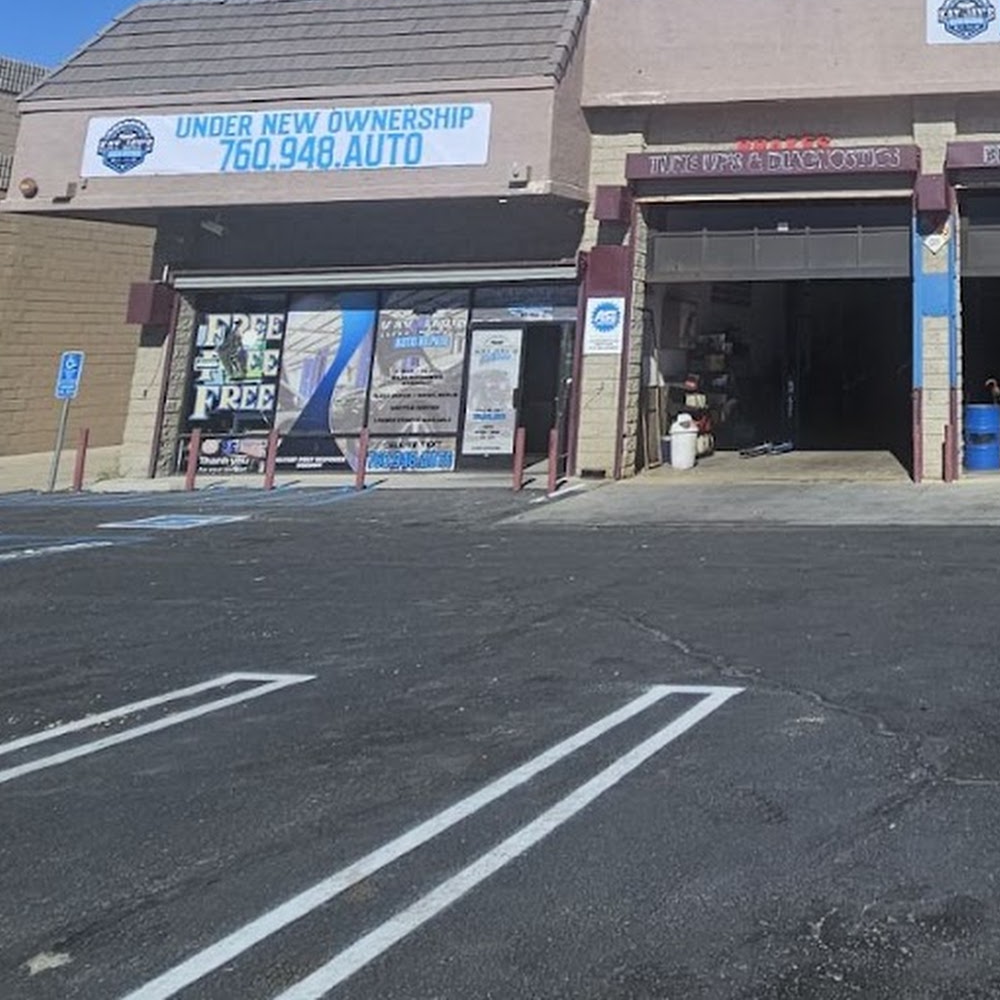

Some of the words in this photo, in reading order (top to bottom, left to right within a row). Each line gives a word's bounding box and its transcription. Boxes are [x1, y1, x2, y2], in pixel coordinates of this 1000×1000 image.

[176, 115, 252, 138] UNDER
[261, 110, 319, 135] NEW
[327, 106, 474, 133] OWNERSHIP
[220, 132, 423, 171] 760.948.AUTO
[204, 313, 285, 347] FREE
[188, 383, 276, 420] FREE
